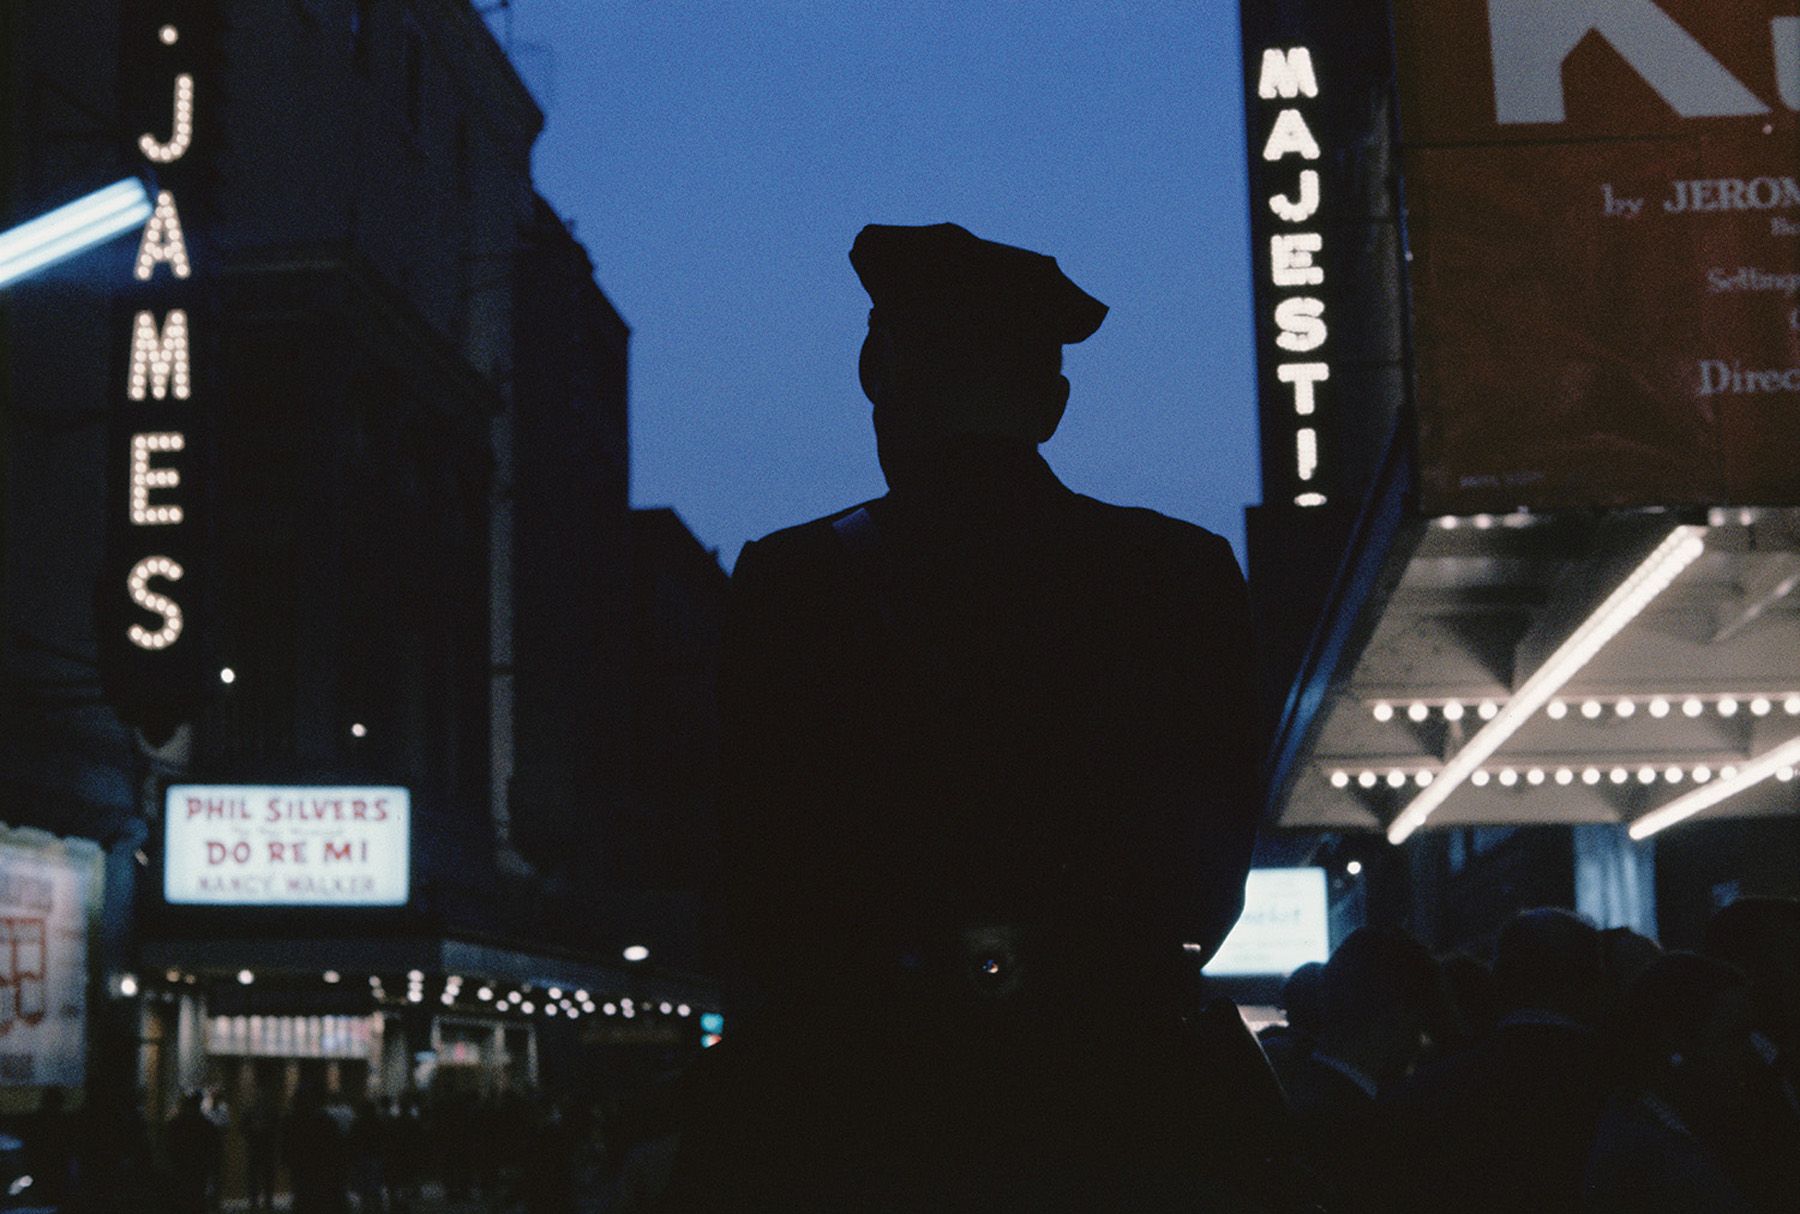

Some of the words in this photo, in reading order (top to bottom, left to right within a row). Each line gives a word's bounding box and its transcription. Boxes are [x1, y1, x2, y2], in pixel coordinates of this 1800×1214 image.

[127, 72, 193, 650] JAMES
[1259, 47, 1329, 506] MAJESTI
[186, 796, 252, 822] PHIL
[266, 797, 389, 823] SILVERS
[206, 840, 252, 866] DO
[267, 840, 308, 865] RE
[323, 840, 368, 865] MI
